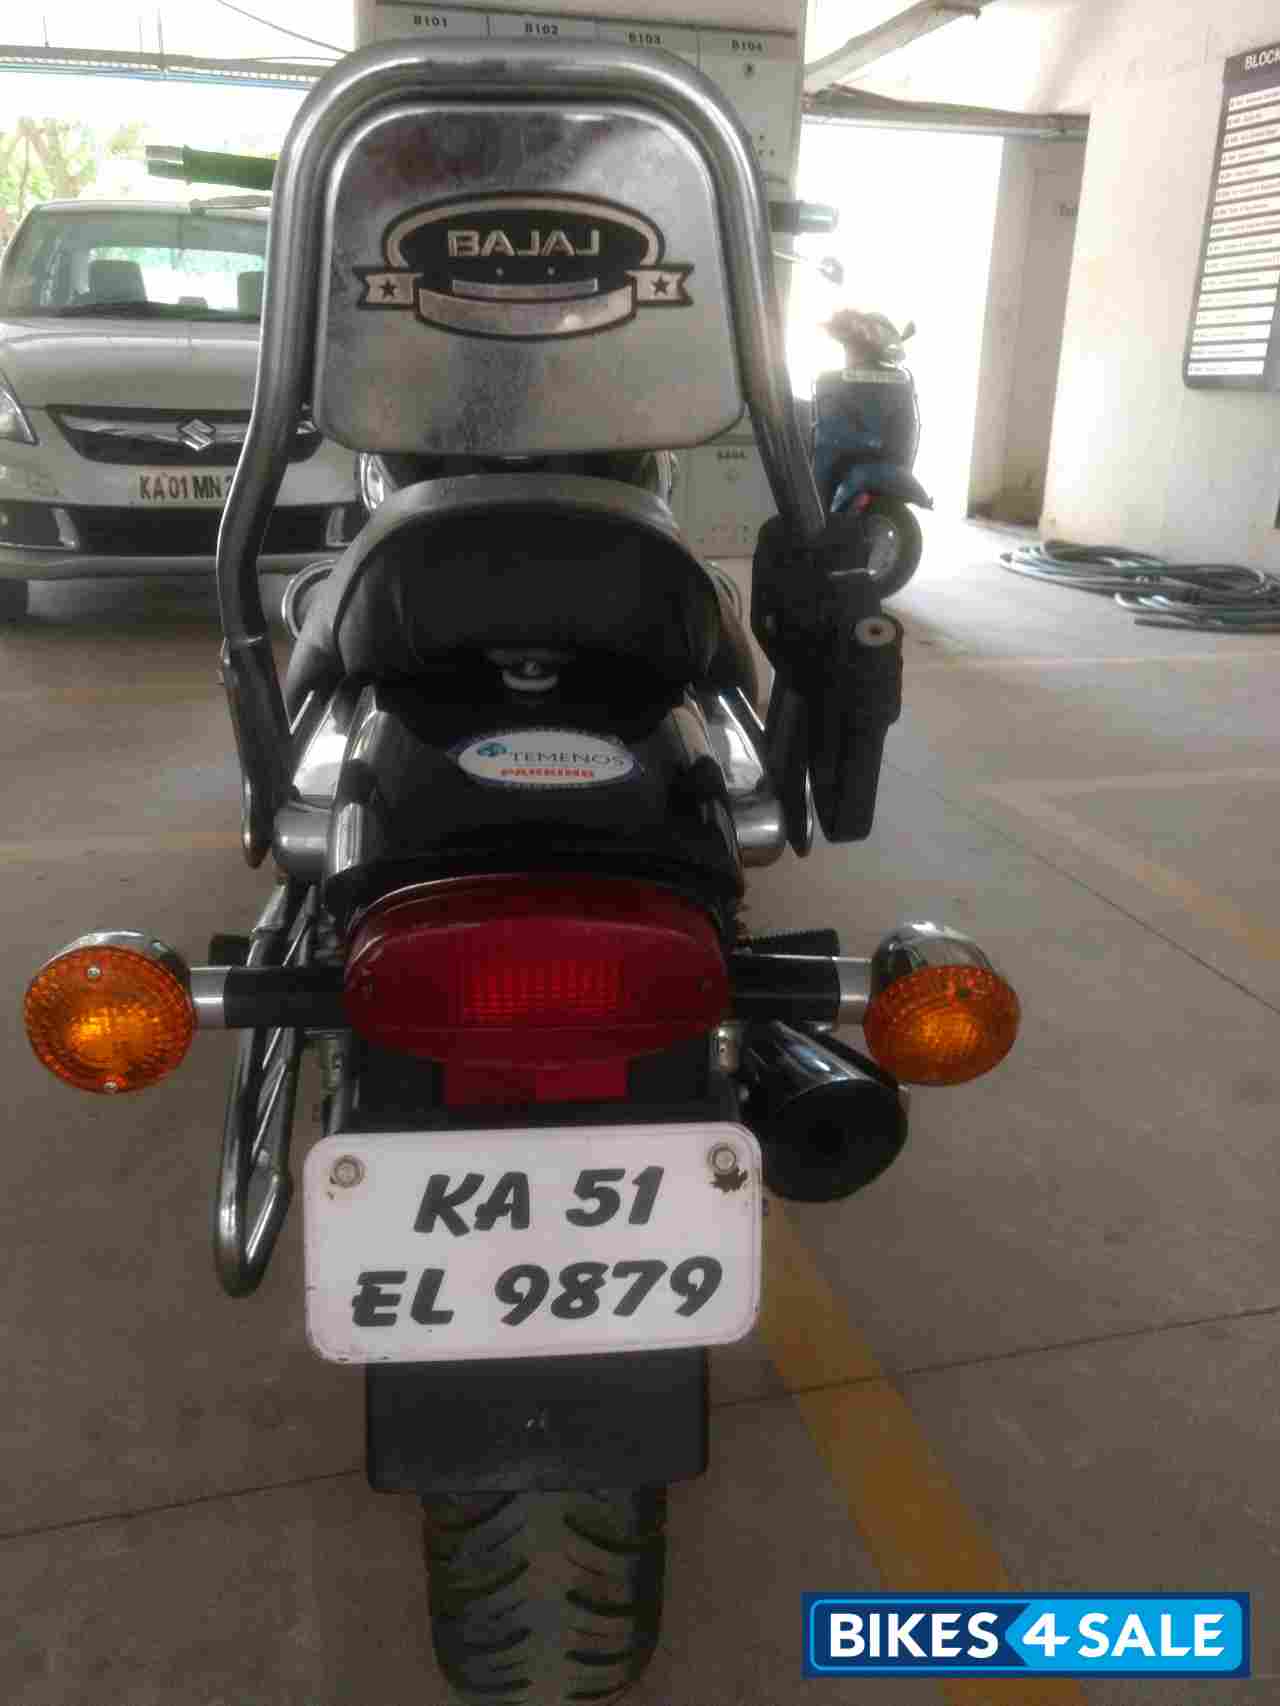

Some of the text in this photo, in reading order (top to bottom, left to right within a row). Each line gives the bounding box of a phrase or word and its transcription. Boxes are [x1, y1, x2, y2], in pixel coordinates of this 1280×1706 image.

[413, 15, 447, 28] B101
[524, 22, 559, 35] B102
[448, 229, 600, 257] BAJAJ
[192, 475, 222, 499] MN
[512, 751, 625, 767] TEMENOS
[413, 1166, 665, 1237] KA 51
[351, 1256, 723, 1327] EL 9879
